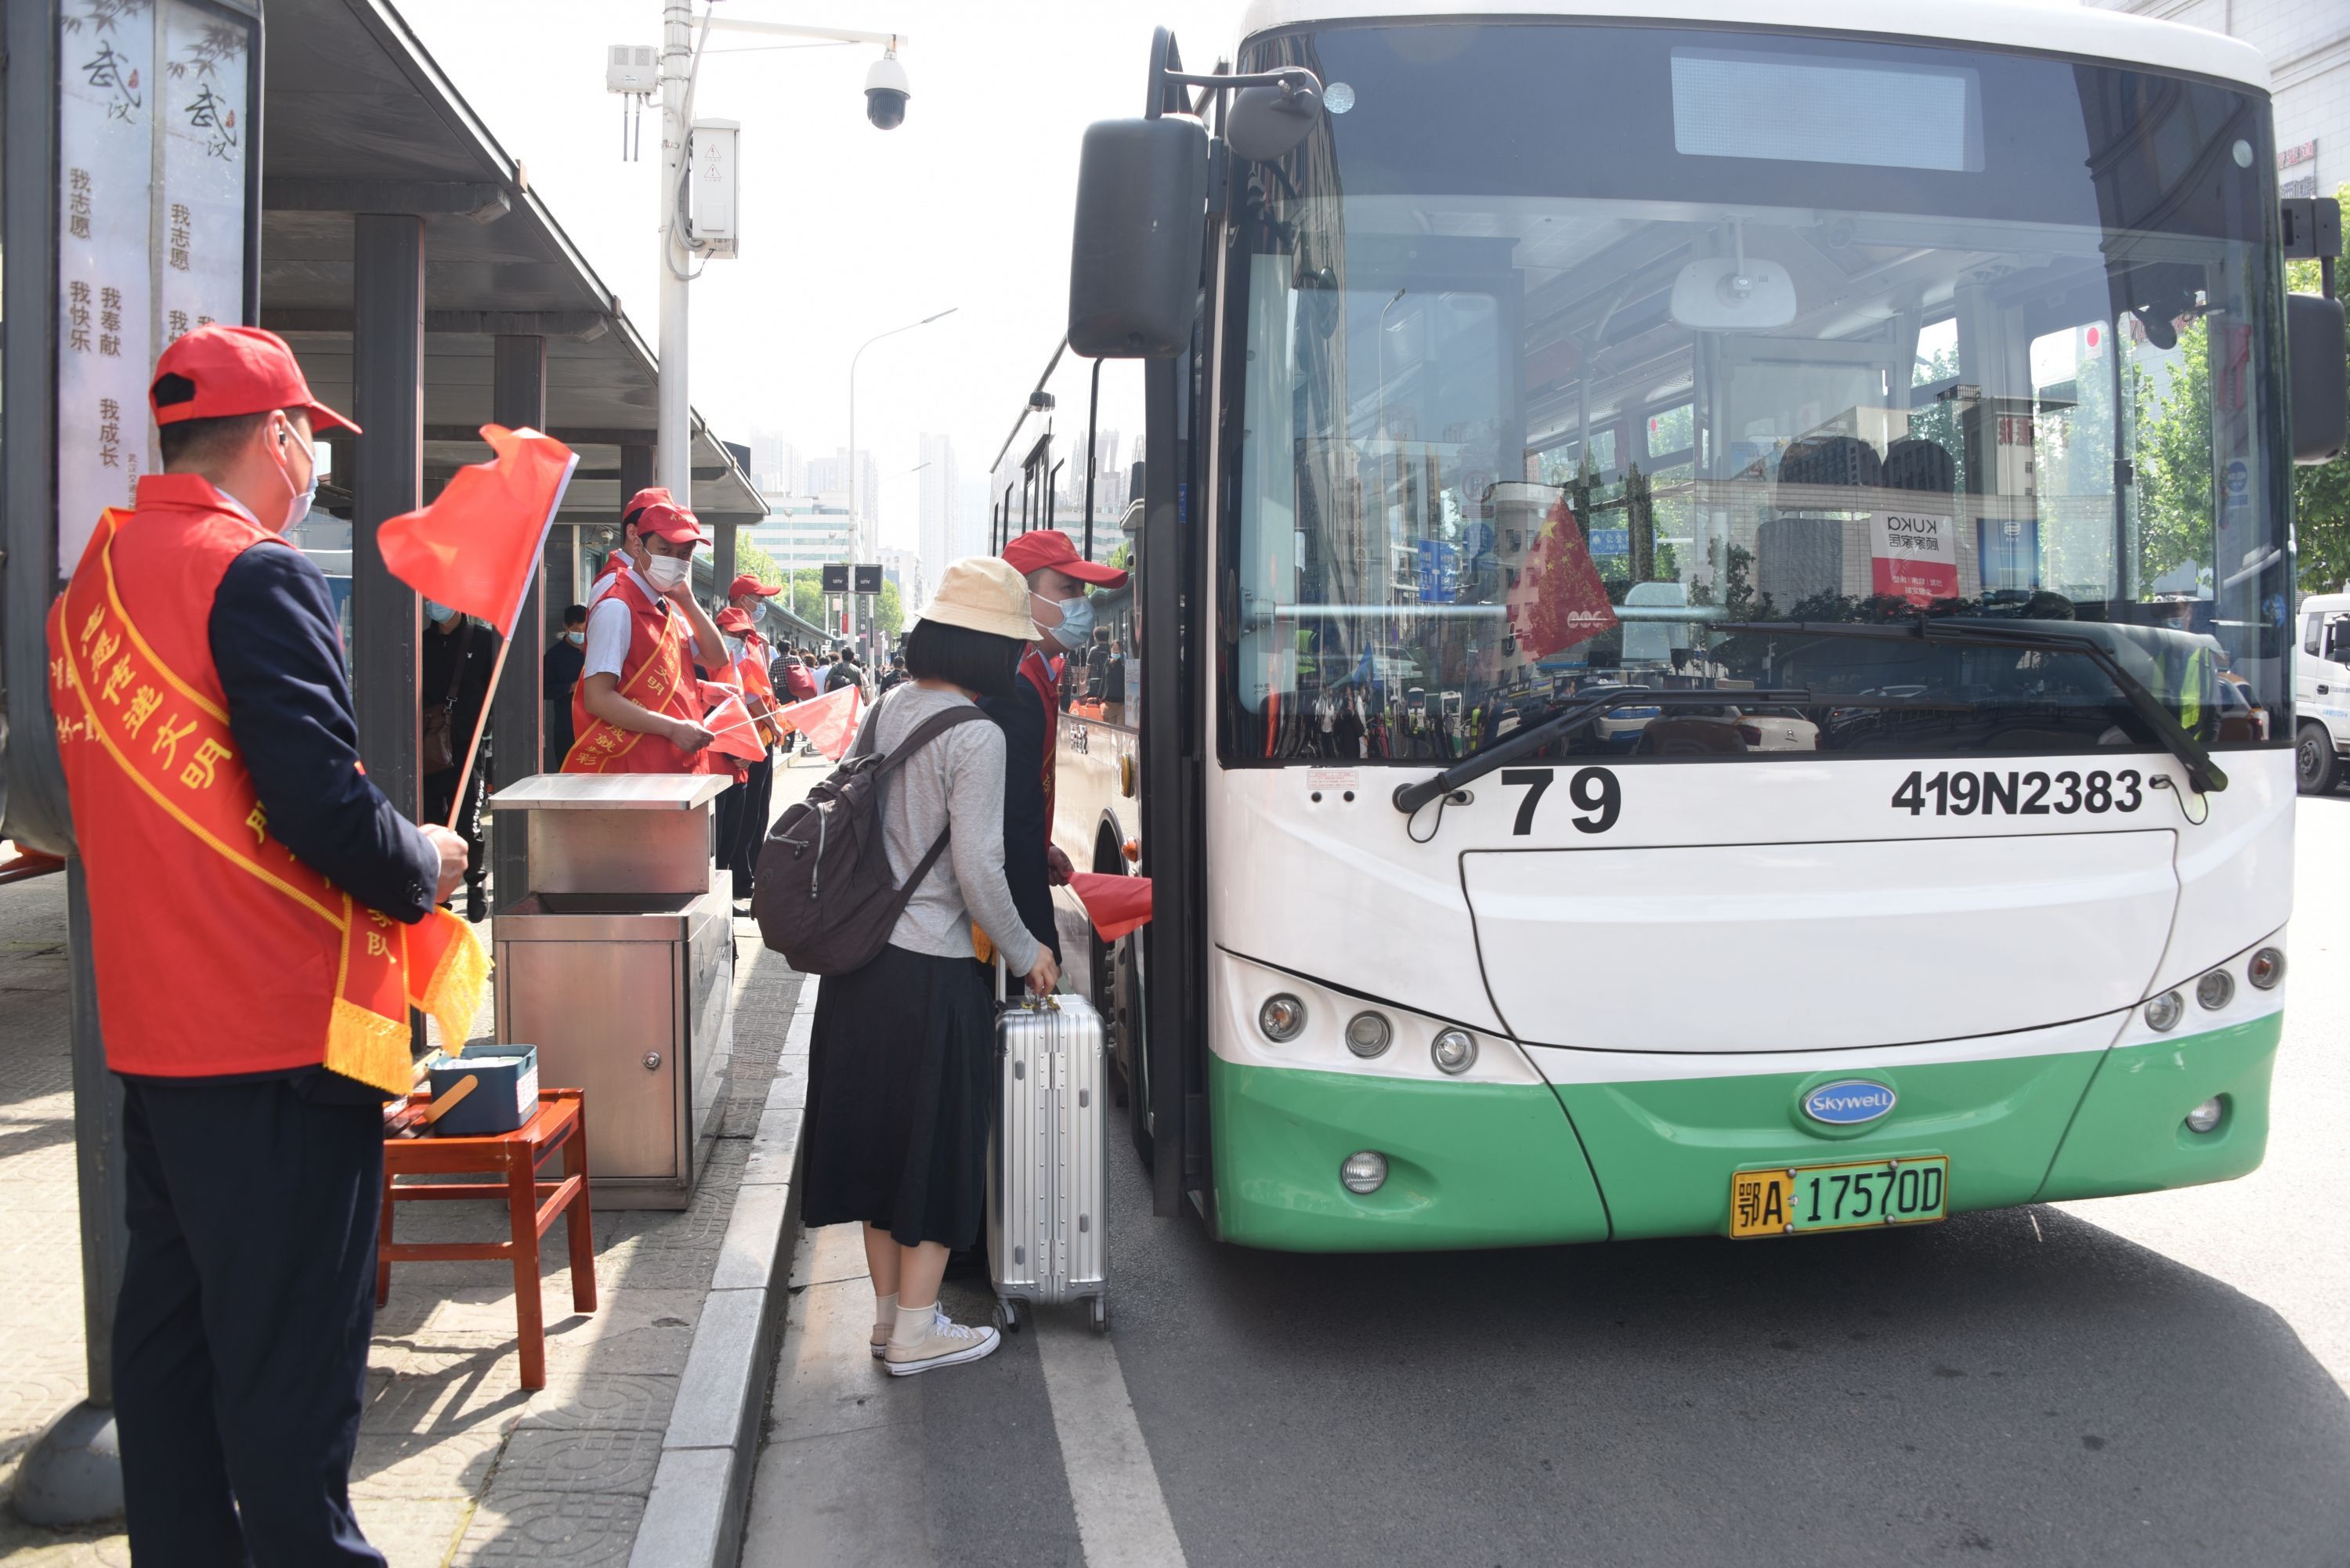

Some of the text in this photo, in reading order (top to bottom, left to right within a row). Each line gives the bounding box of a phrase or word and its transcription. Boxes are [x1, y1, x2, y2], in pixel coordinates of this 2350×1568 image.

[82, 39, 141, 125] 武汉
[185, 83, 237, 162] 武汉
[70, 168, 91, 240] 我志愿
[170, 204, 191, 271] 我志愿
[70, 280, 92, 353] 我快乐
[99, 287, 121, 358] 我奉献
[99, 398, 120, 468] 我成长
[1501, 766, 1622, 836] 79
[1891, 769, 2142, 815] 419N2383
[1813, 1092, 1890, 1111] Skywell
